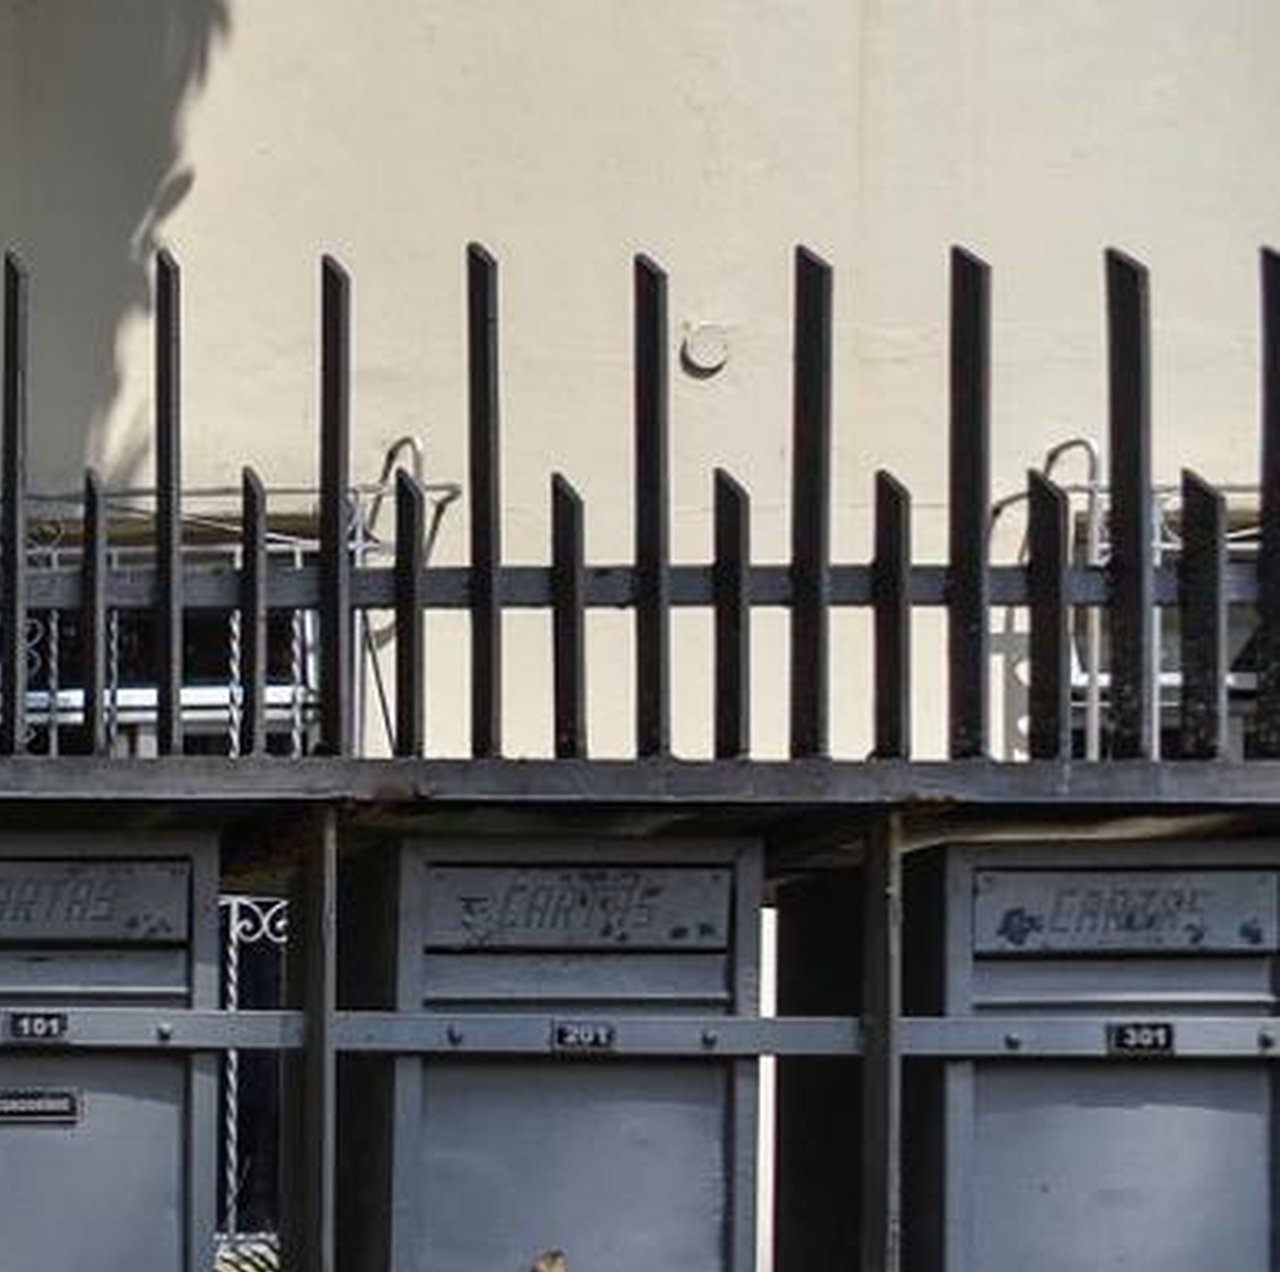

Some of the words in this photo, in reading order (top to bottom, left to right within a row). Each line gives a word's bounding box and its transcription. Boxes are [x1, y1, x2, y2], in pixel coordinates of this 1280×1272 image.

[18, 1017, 60, 1036] 101
[562, 1026, 609, 1044] 201
[1122, 1027, 1167, 1047] 301
